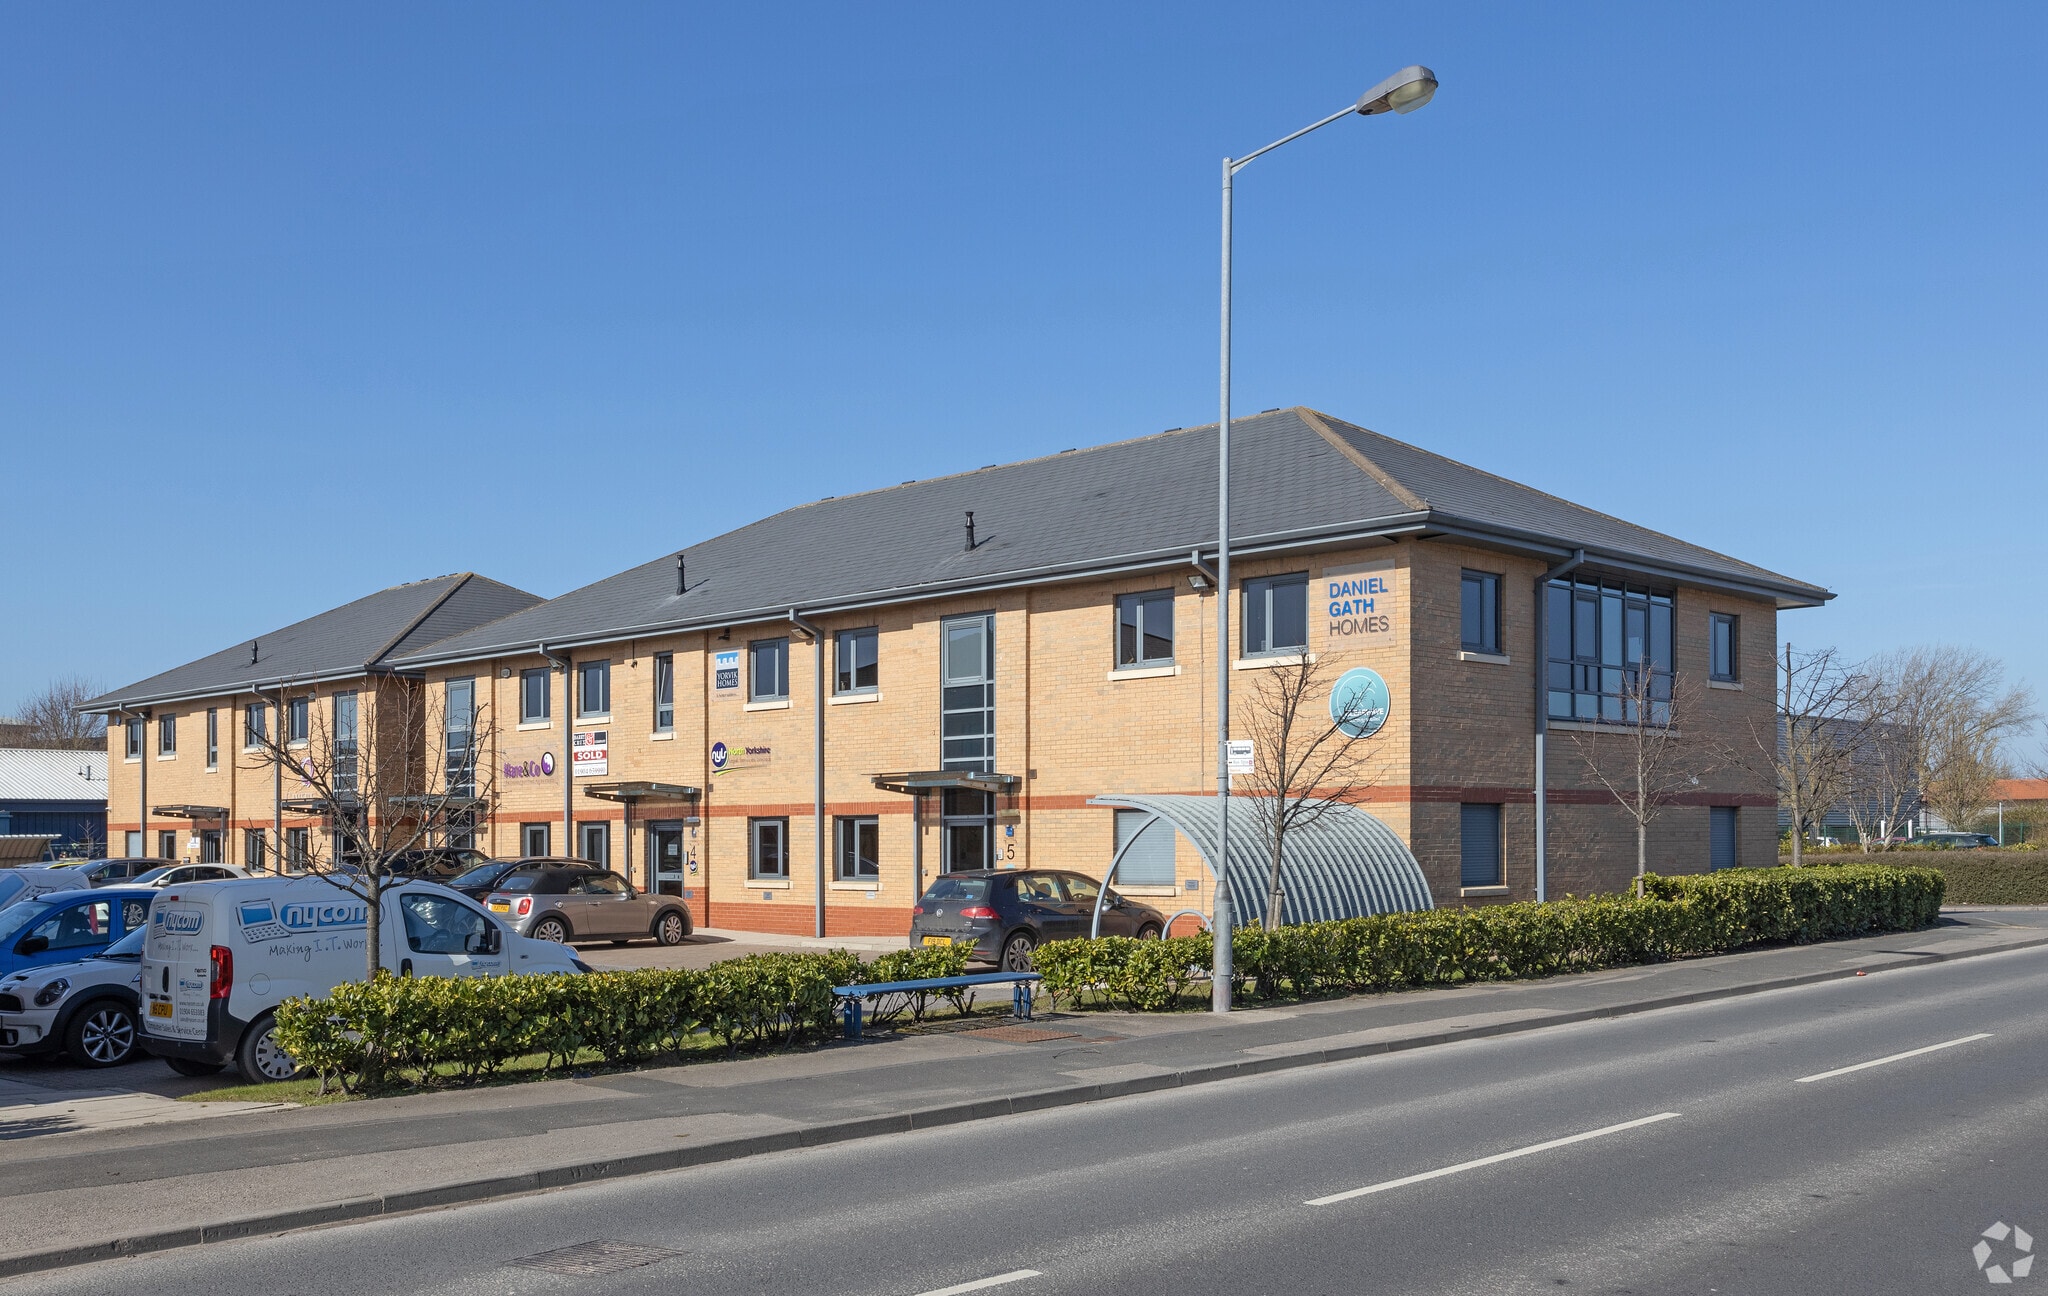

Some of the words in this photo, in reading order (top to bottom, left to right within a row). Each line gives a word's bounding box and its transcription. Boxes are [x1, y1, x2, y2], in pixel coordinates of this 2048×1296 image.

[1329, 577, 1388, 599] DANIEL
[1329, 598, 1375, 617] GATH
[1329, 615, 1389, 636] HOMES
[717, 671, 738, 681] YORVIK
[717, 679, 738, 688] HOMES
[577, 751, 603, 760] SOLD
[728, 747, 745, 756] North
[745, 745, 771, 756] Yorkshire
[690, 846, 697, 859] 4
[1006, 844, 1015, 860] 5
[166, 912, 198, 931] nycom
[269, 942, 312, 962] Making
[158, 1005, 168, 1015] CPU
[176, 1025, 192, 1035] Service
